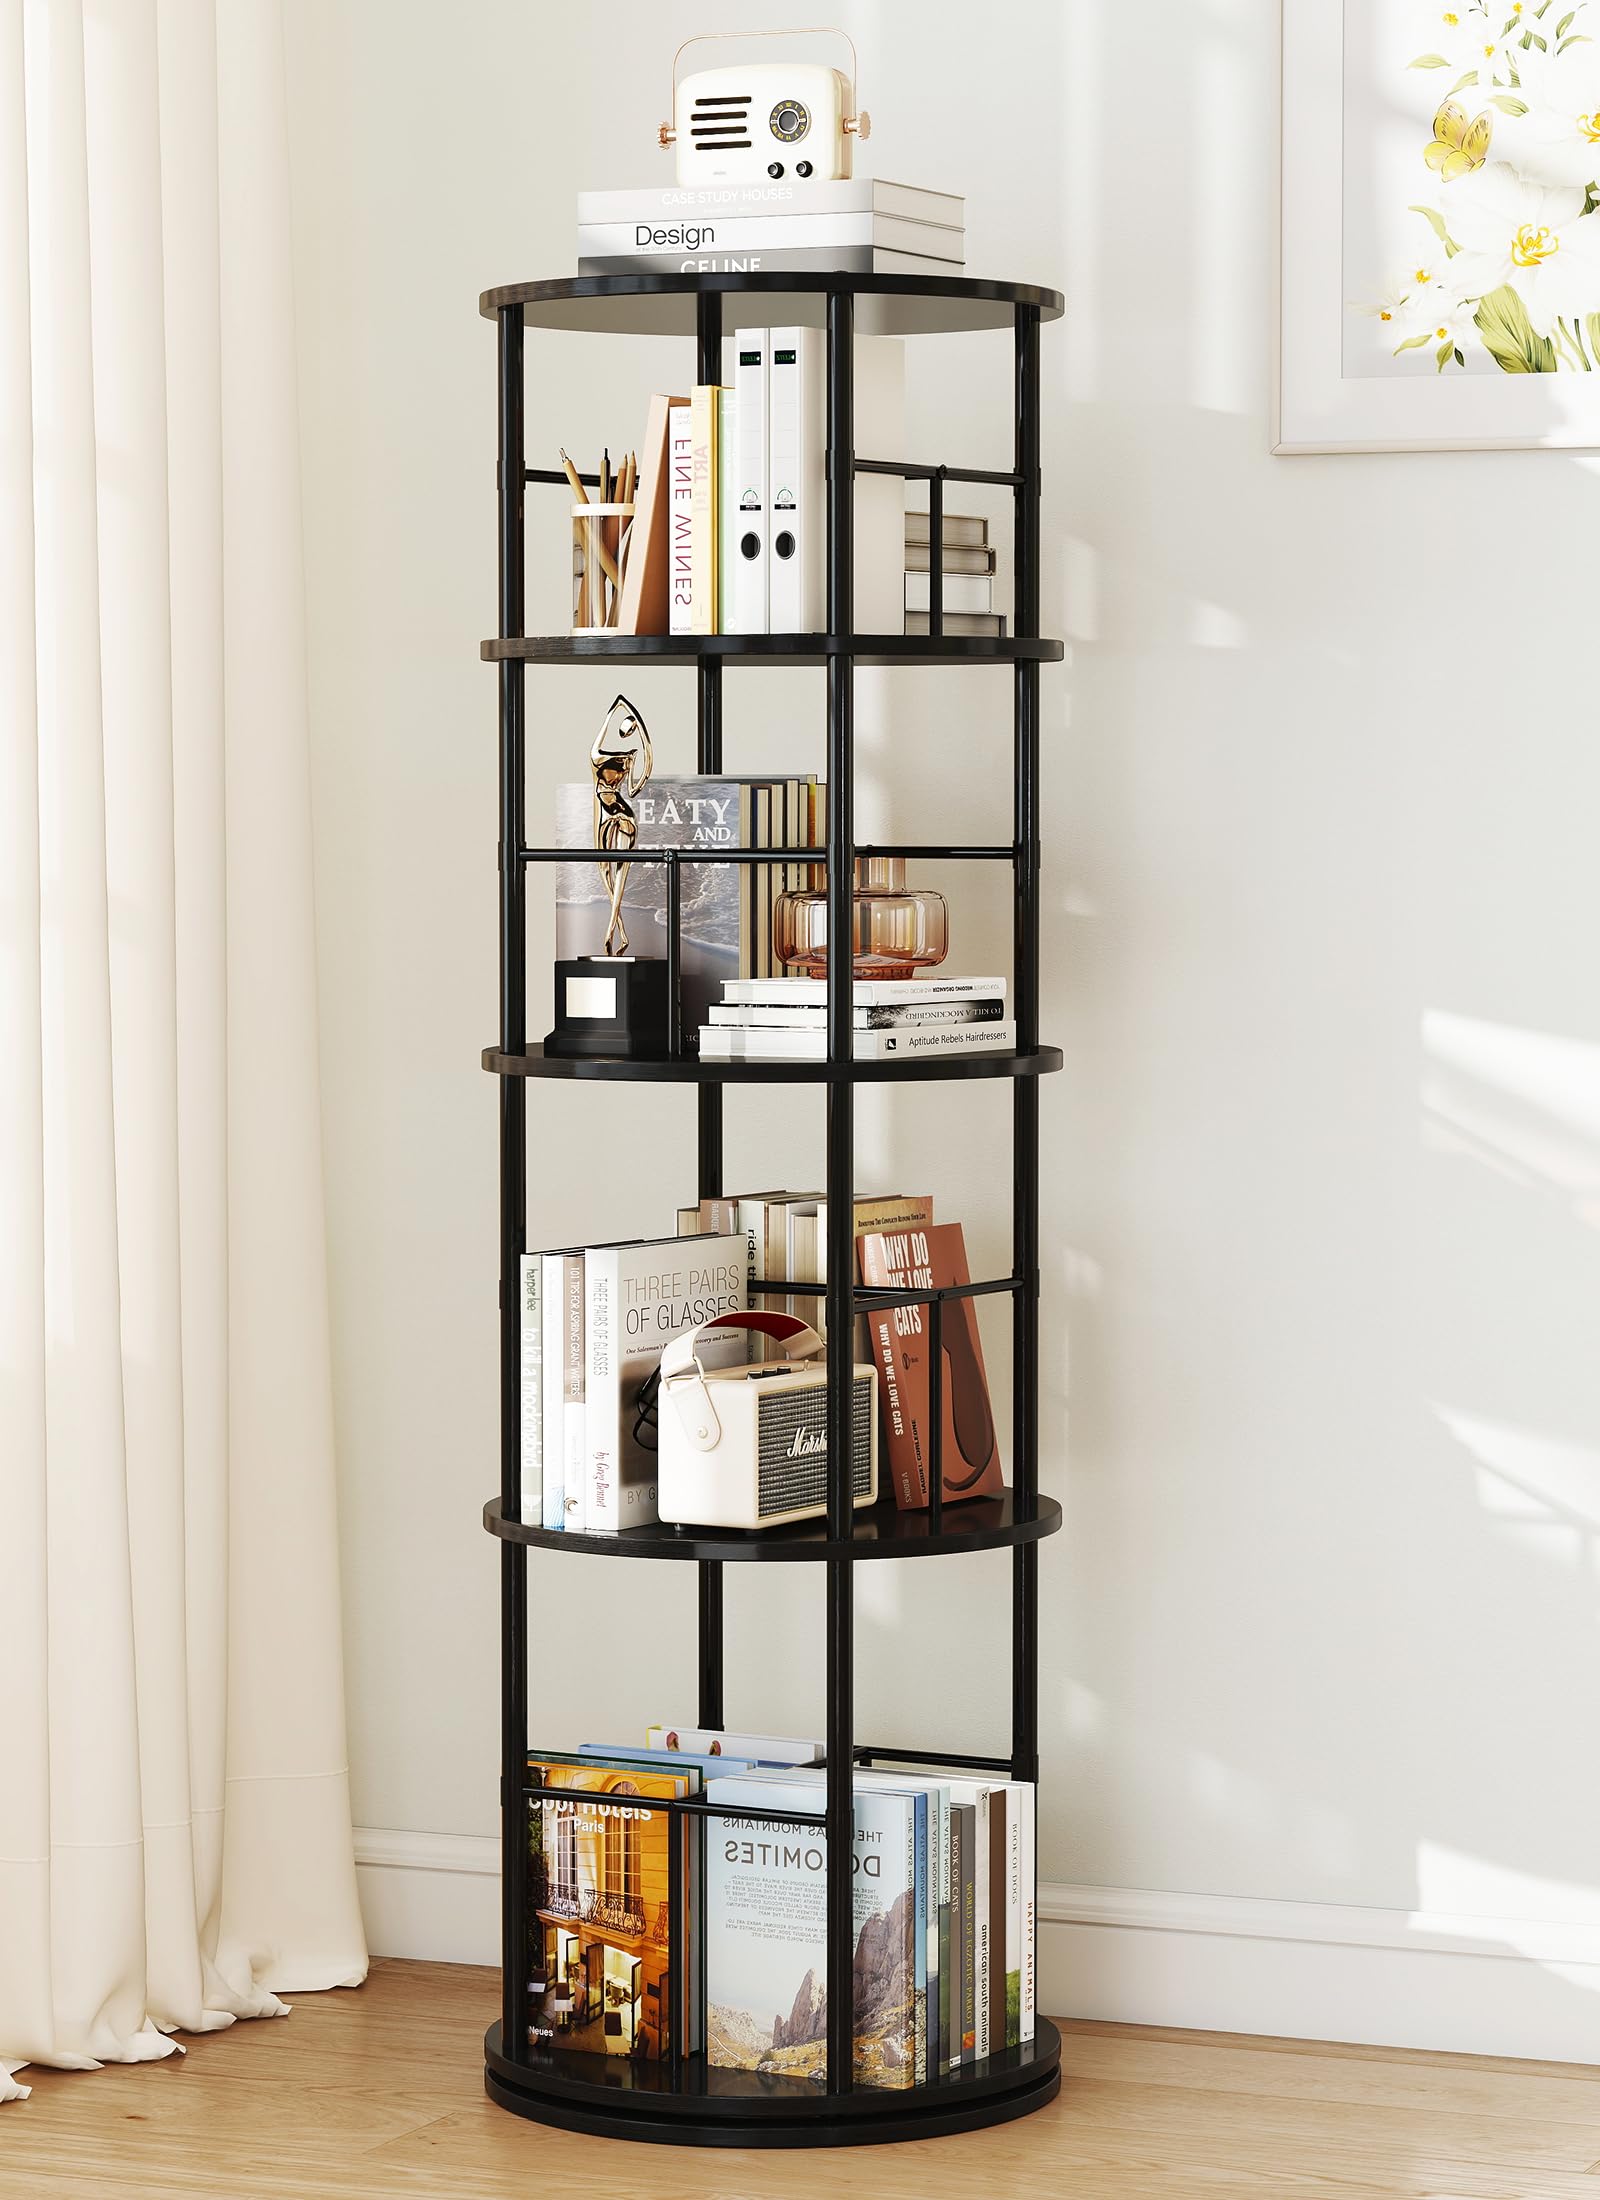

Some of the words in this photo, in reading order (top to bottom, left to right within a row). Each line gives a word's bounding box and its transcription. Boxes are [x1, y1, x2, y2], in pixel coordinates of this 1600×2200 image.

[662, 192, 697, 205] CASE
[698, 190, 738, 204] STUDY
[742, 188, 793, 201] HOUSES
[636, 224, 715, 250] Design
[637, 799, 732, 825] EATY
[692, 827, 731, 842] AND
[906, 1010, 964, 1020] MOCKINGBIRD
[974, 1008, 989, 1016] KILL
[991, 1007, 1000, 1015] TO
[908, 1035, 939, 1048] Aptitude
[941, 1033, 964, 1044] Rebels
[966, 1031, 1006, 1042] Hairdressers
[748, 1229, 756, 1260] ride
[880, 1235, 910, 1270] WHY
[911, 1232, 929, 1266] DO
[524, 1268, 538, 1296] harper
[748, 1266, 756, 1281] th
[593, 1278, 608, 1303] THREE
[624, 1272, 682, 1304] THREE
[690, 1264, 740, 1295] PAIRS
[527, 1298, 540, 1311] lee
[570, 1296, 580, 1310] FOR
[593, 1304, 608, 1326] PAIRS
[626, 1307, 650, 1334] OF
[658, 1295, 739, 1330] GLASSES
[894, 1304, 922, 1336] CATS
[570, 1310, 580, 1342] ASPIRING
[879, 1323, 890, 1346] WHY
[593, 1330, 608, 1340] OF
[570, 1342, 580, 1366] GRANT
[593, 1342, 608, 1376] GLASSES
[883, 1348, 892, 1363] DO
[523, 1368, 536, 1377] a
[886, 1366, 895, 1382] WE
[888, 1384, 900, 1408] LOVE
[522, 1381, 542, 1468] mockingbird
[892, 1410, 903, 1436] CATS
[787, 1426, 827, 1457] Marsh
[593, 1452, 609, 1461] by
[594, 1462, 609, 1481] Greg
[628, 1490, 641, 1504] BY
[574, 1818, 604, 1833] Paris
[1012, 1857, 1018, 1870] OF
[952, 1869, 959, 1883] OF
[966, 1922, 973, 1935] OF
[528, 2026, 553, 2037] Neues
